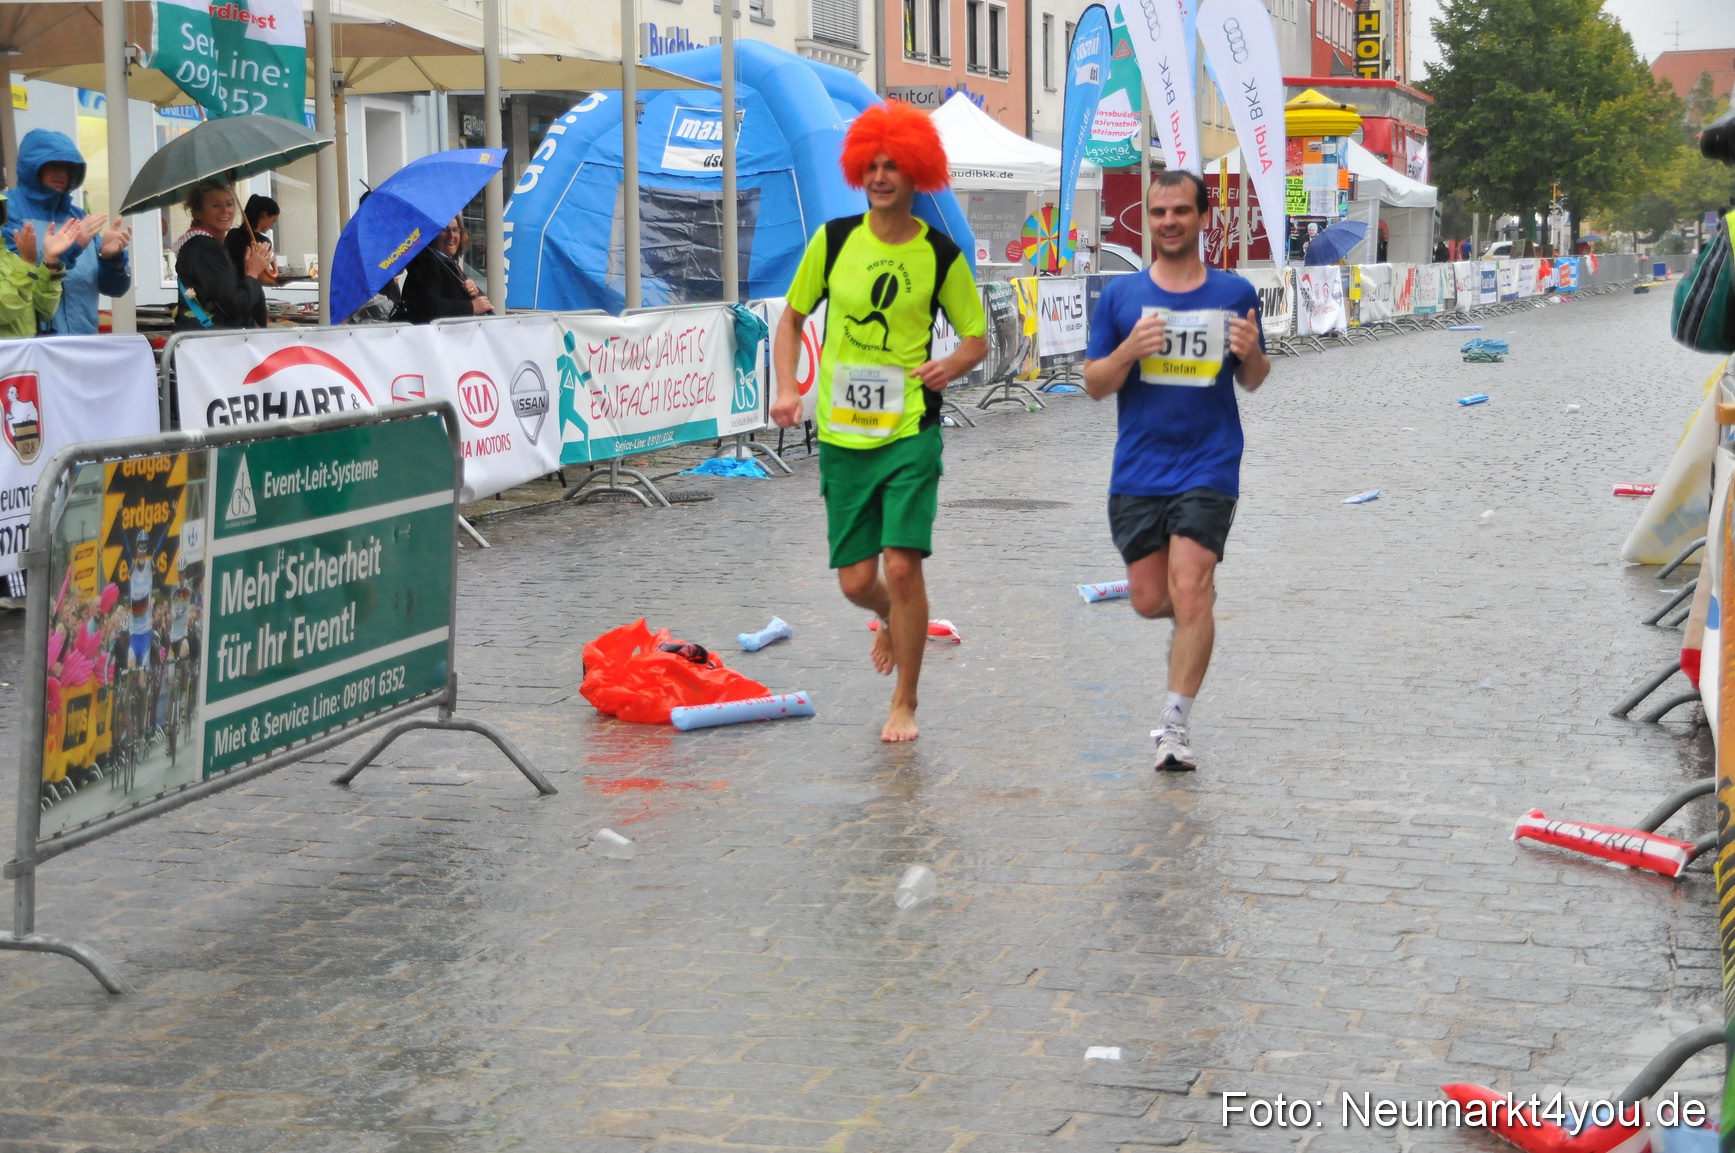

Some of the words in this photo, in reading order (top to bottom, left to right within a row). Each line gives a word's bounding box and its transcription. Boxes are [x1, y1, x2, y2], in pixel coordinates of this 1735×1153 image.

[675, 118, 723, 141] max
[975, 231, 990, 239] udi
[1158, 330, 1207, 358] 515
[1162, 362, 1197, 374] Stefan
[206, 385, 346, 428] GERHART
[352, 392, 362, 410] &
[461, 383, 495, 416] KIA
[845, 384, 885, 410] 431
[851, 414, 878, 426] Armin
[475, 433, 512, 457] MOTORS
[122, 453, 172, 481] erdgas
[263, 458, 379, 499] Event-Leit-Systeme
[121, 498, 170, 533] erdgas
[221, 560, 280, 617] Mehr
[285, 535, 382, 600] Sicherheit
[217, 633, 252, 683] für
[257, 622, 287, 671] Ihr
[293, 601, 357, 659] Event!
[214, 723, 247, 757] Miet
[250, 716, 260, 744] &
[264, 704, 309, 740] Service
[312, 692, 341, 722] Line:
[343, 675, 376, 710] 09181
[379, 665, 406, 697] 6352
